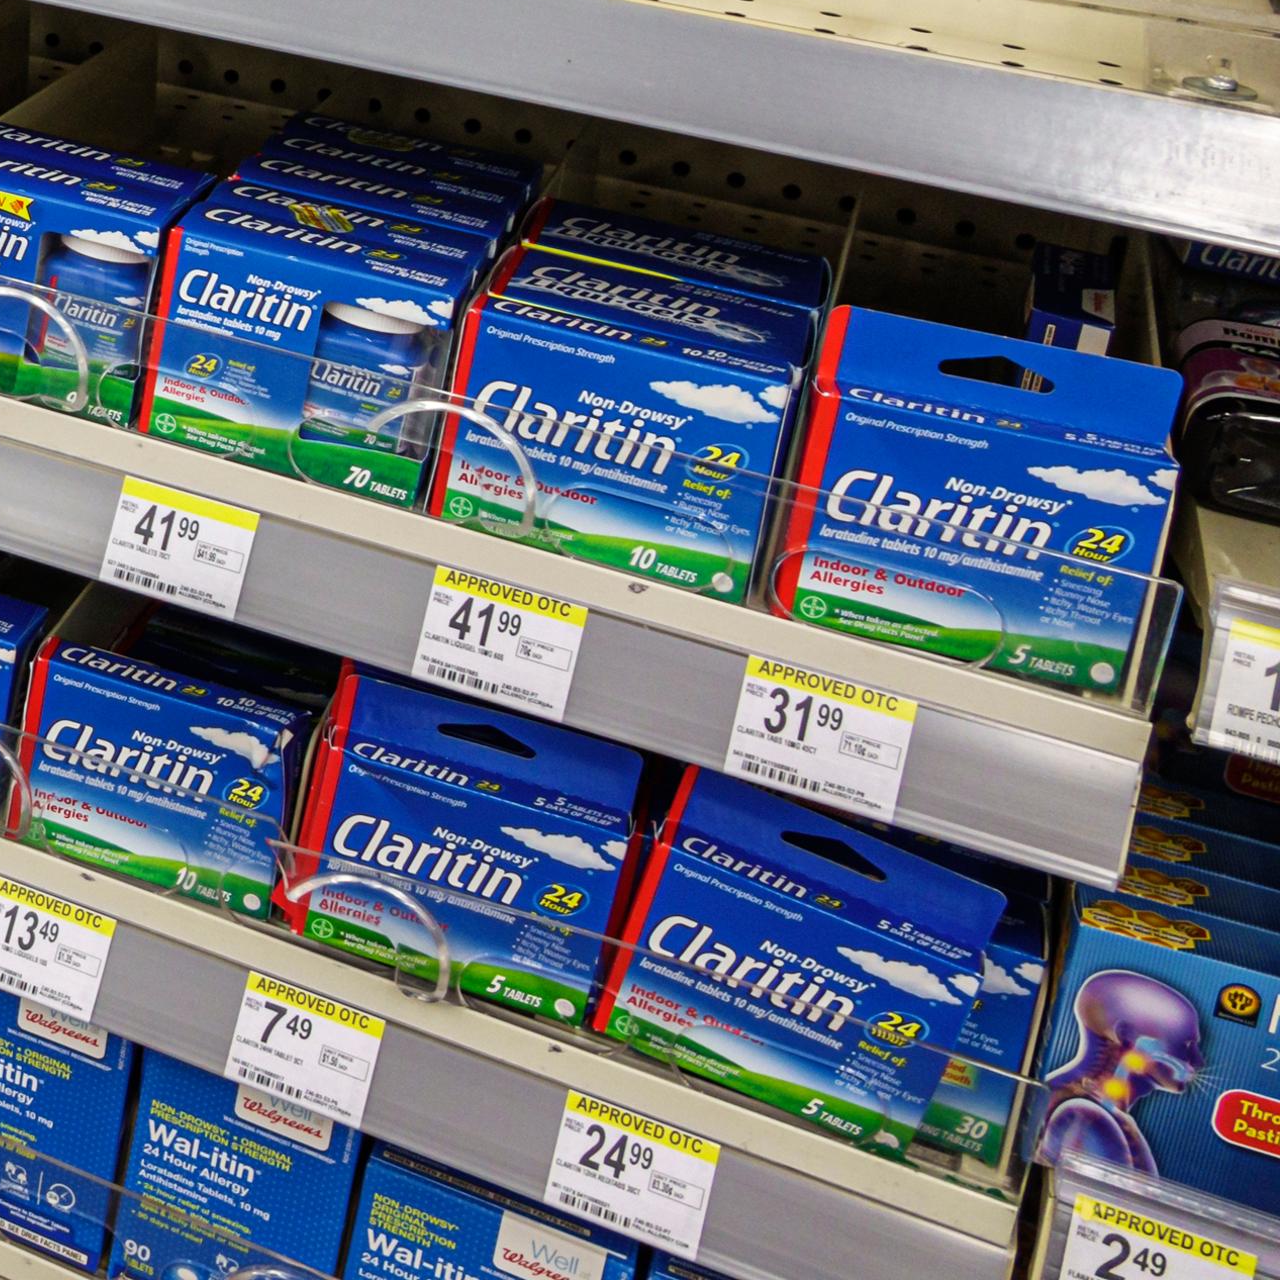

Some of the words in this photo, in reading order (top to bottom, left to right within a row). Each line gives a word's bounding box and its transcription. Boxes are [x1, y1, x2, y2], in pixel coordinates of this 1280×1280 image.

[179, 269, 313, 332] Claritin
[846, 412, 886, 430] Original
[888, 422, 944, 442] Prescription
[946, 432, 988, 450] Strength
[826, 469, 1053, 560] Claritin
[810, 569, 884, 596] Allergies
[812, 556, 870, 578] Indoor
[874, 570, 888, 581] &
[894, 572, 965, 598] Outdoor
[759, 660, 856, 700] APPROVED
[860, 686, 898, 711] OTC
[42, 720, 214, 803] Claritin
[648, 914, 855, 1032] Claritin
[243, 1096, 323, 1141] Walgreens
[147, 1120, 256, 1184] Wal-itin
[1092, 1202, 1195, 1250] APPROVED
[1200, 1242, 1240, 1266] OTC
